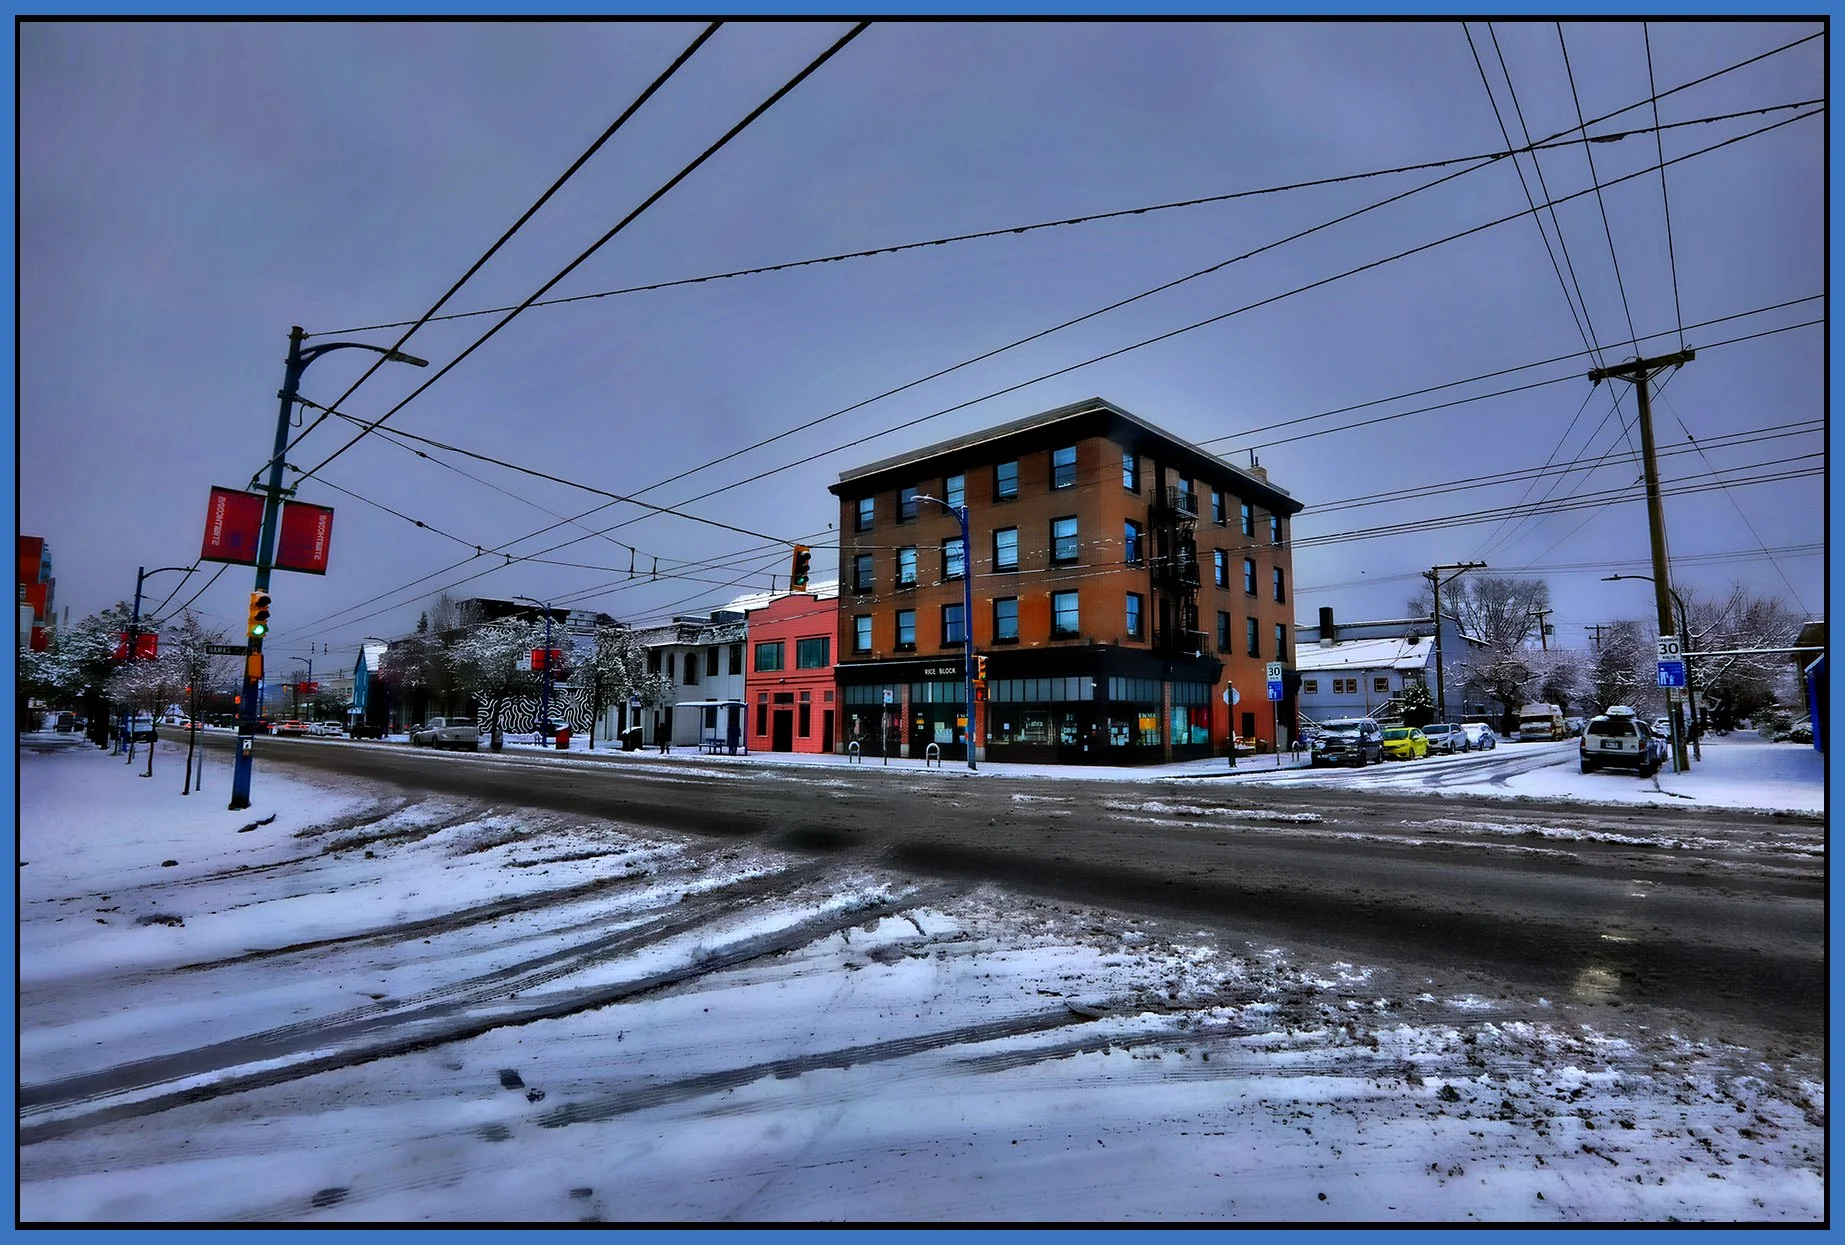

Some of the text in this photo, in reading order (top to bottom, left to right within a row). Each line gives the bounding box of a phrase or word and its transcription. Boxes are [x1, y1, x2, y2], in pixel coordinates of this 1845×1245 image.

[208, 646, 231, 654] HAWKS
[1659, 643, 1679, 654] 30
[938, 667, 957, 675] BLOCK
[1268, 667, 1281, 676] 30
